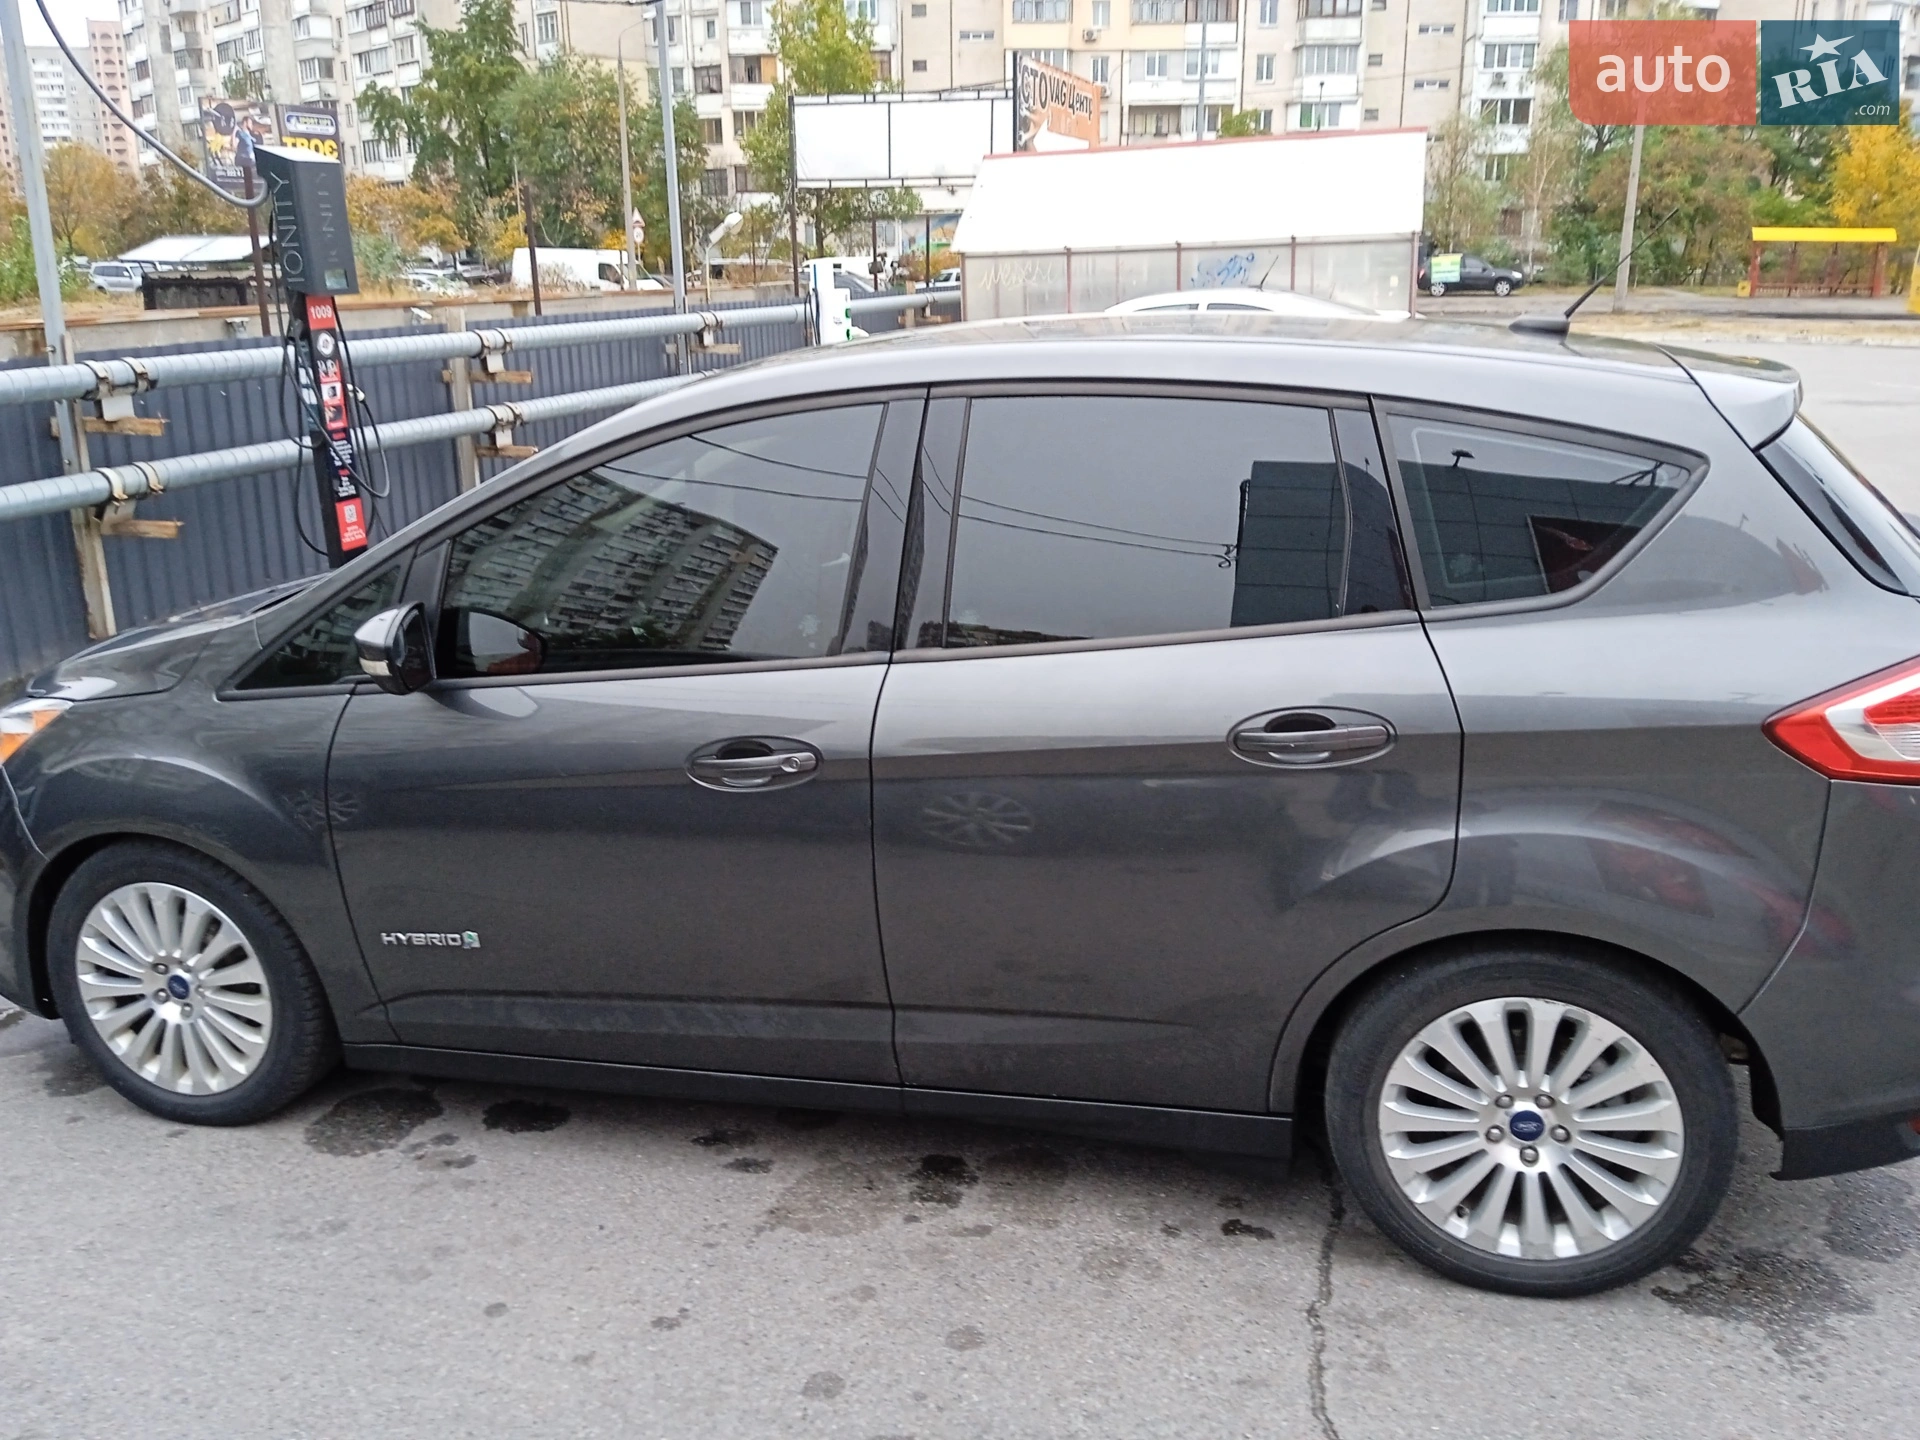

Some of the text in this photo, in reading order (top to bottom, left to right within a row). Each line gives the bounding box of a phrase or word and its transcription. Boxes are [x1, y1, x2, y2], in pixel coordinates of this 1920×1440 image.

[1021, 64, 1048, 110] СТО
[1049, 74, 1067, 108] VAG
[269, 171, 305, 282] IONITY
[310, 305, 333, 319] 1009
[380, 932, 462, 946] HYBRID
